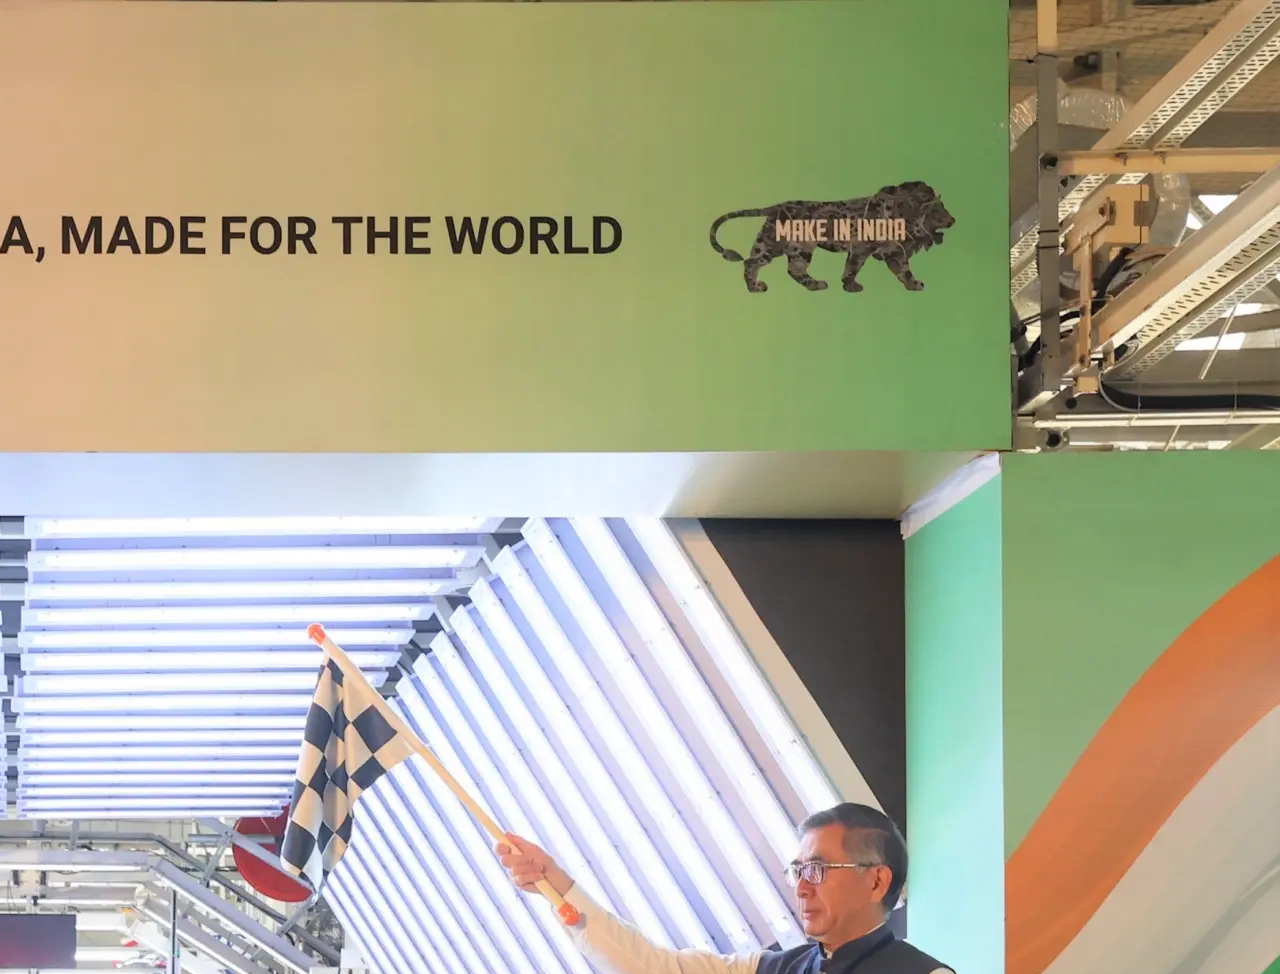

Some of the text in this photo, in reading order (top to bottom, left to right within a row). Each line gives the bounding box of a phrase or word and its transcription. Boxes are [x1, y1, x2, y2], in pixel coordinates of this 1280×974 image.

[61, 215, 206, 255] MADE
[221, 216, 318, 255] FOR
[331, 216, 431, 255] THE
[444, 215, 623, 255] WORLD
[775, 218, 906, 242] MAKE IN INDIA
